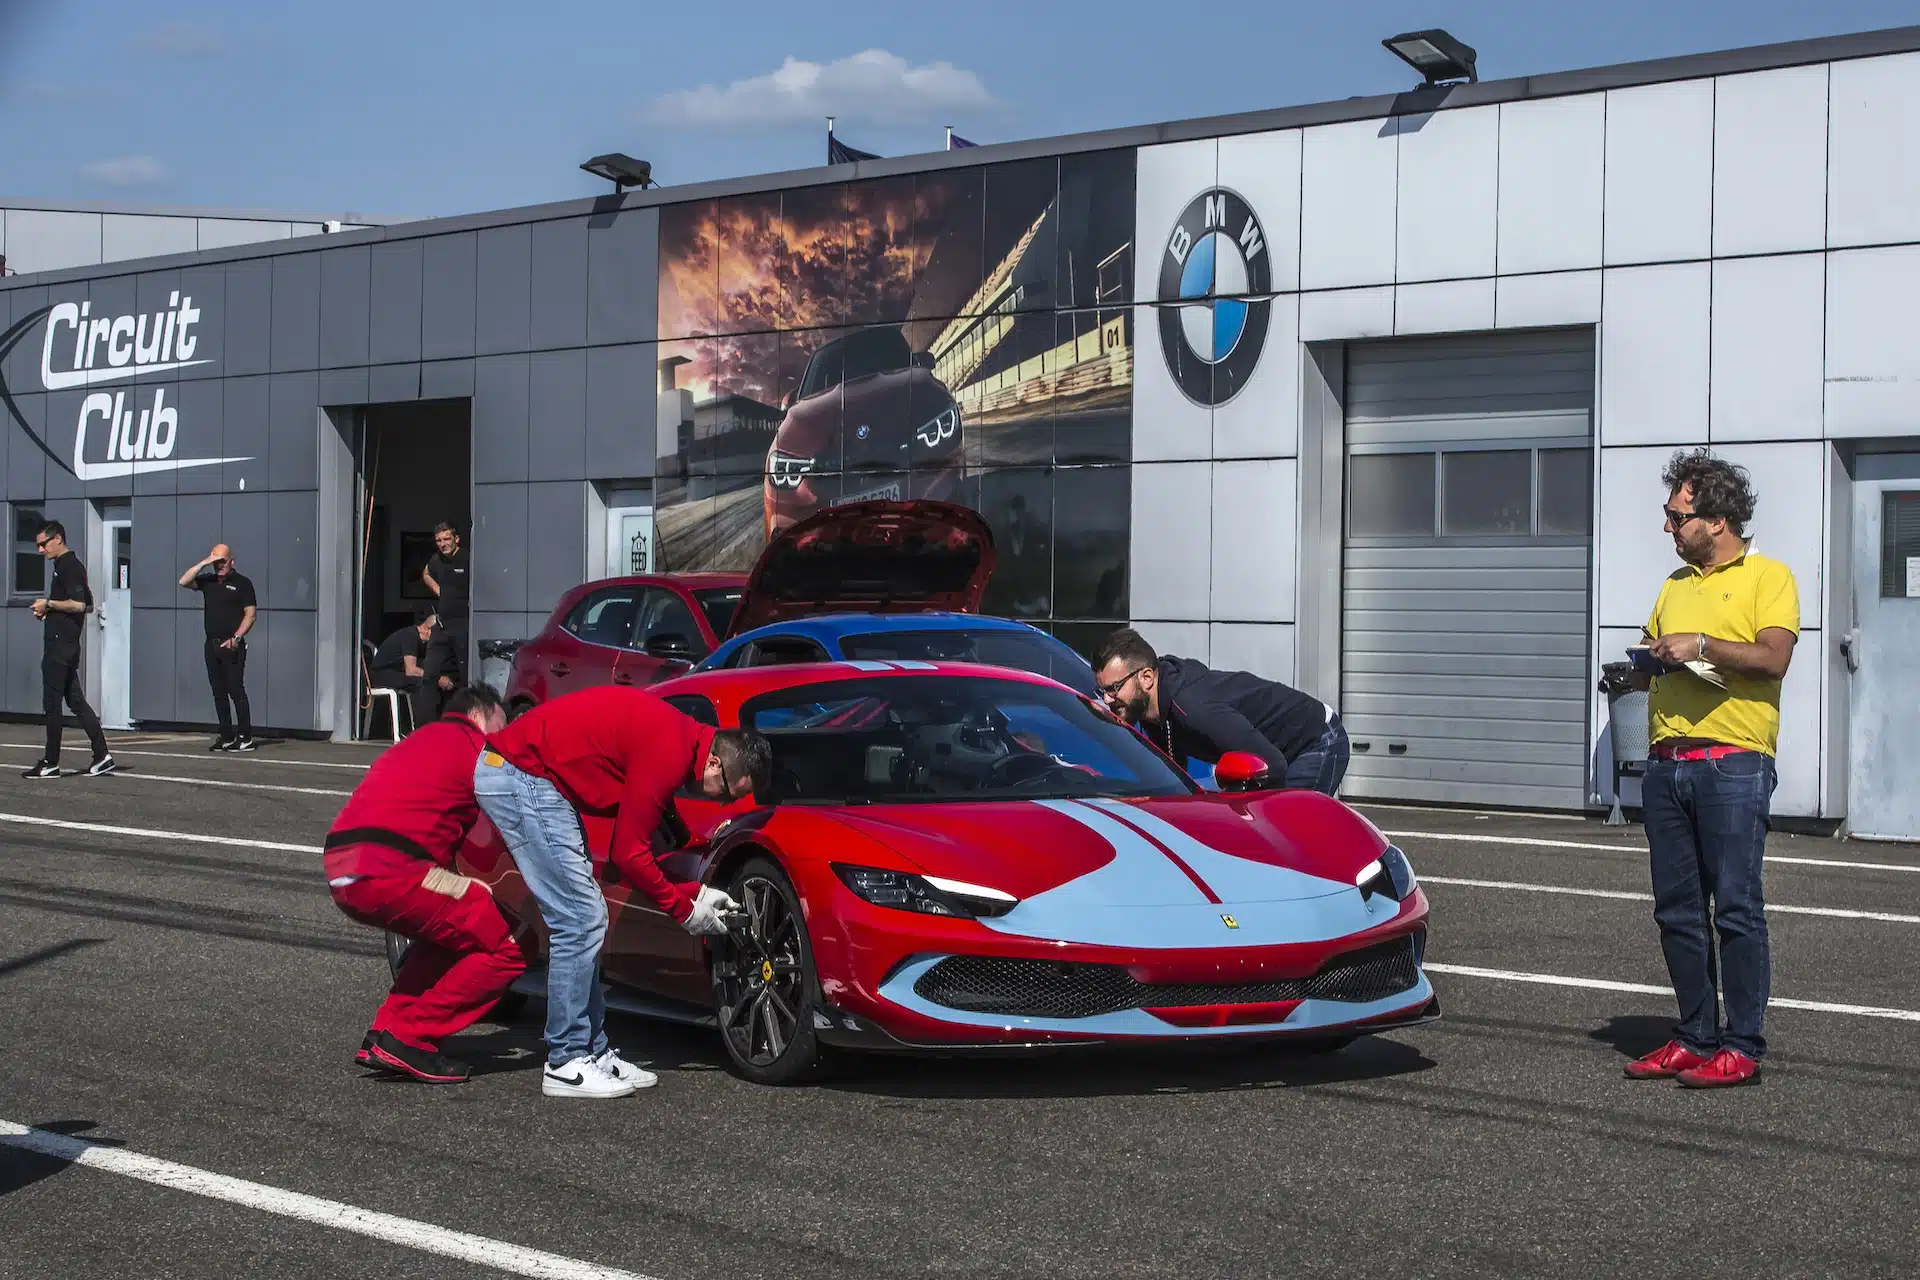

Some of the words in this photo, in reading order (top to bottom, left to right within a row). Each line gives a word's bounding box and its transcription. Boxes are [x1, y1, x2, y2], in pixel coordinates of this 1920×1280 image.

[1169, 194, 1264, 266] BMW
[41, 290, 212, 390] Circuit
[1107, 325, 1119, 349] 01
[73, 388, 222, 481] Club
